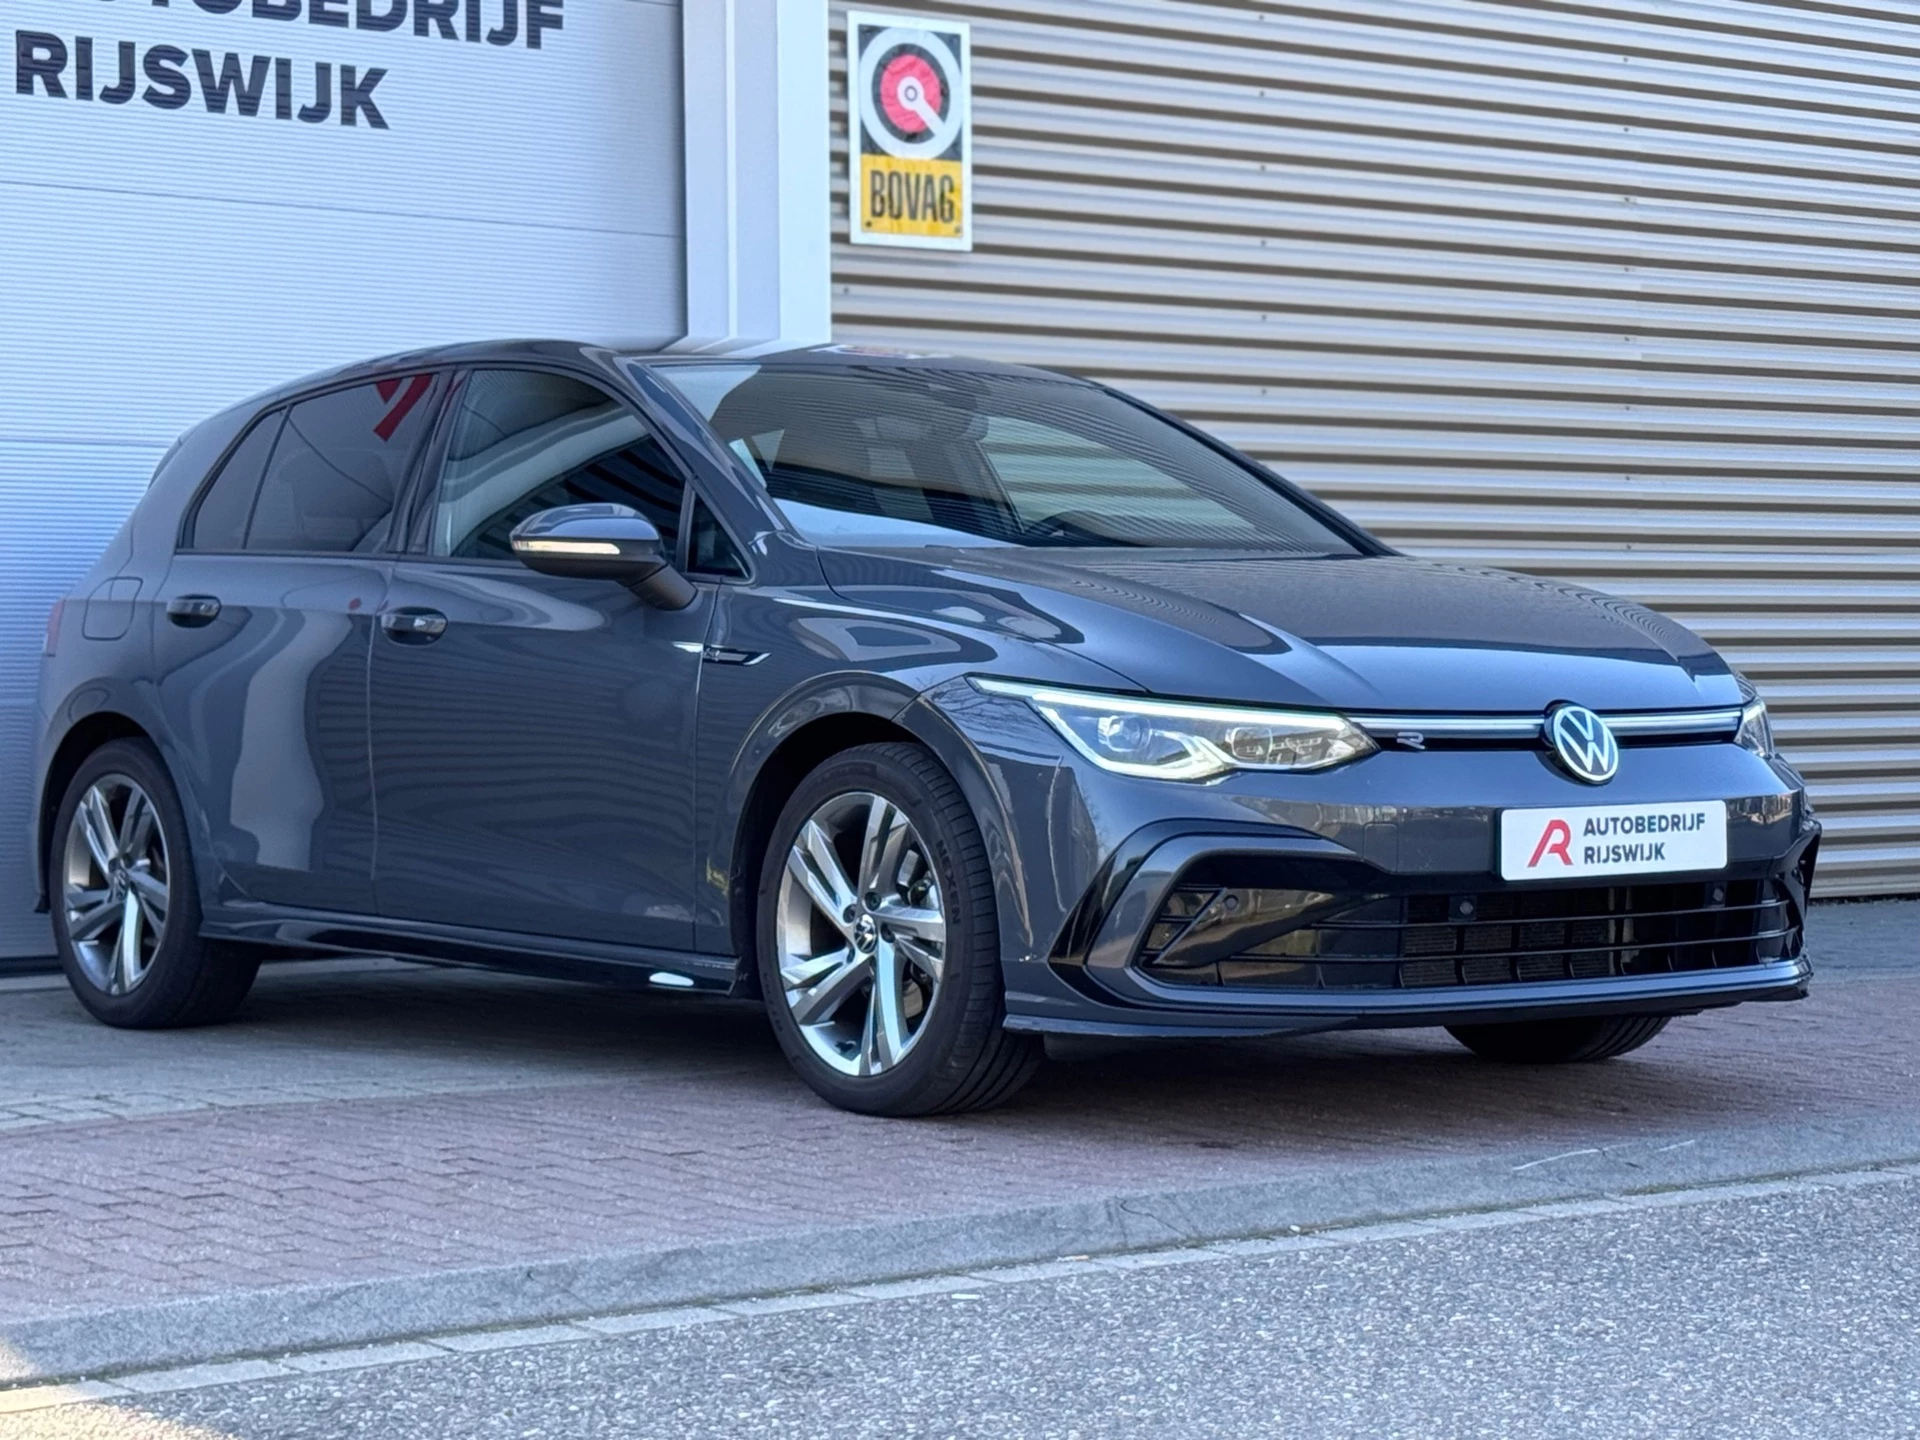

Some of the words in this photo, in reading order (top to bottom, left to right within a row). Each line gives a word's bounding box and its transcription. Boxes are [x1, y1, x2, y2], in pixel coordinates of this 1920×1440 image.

[15, 29, 390, 130] RIJSWIJK
[870, 170, 954, 224] BOVAG
[1583, 812, 1706, 837] AUTOBEDRIJF
[1583, 842, 1666, 865] RIJSWIJK
[935, 839, 962, 925] NEXEN
